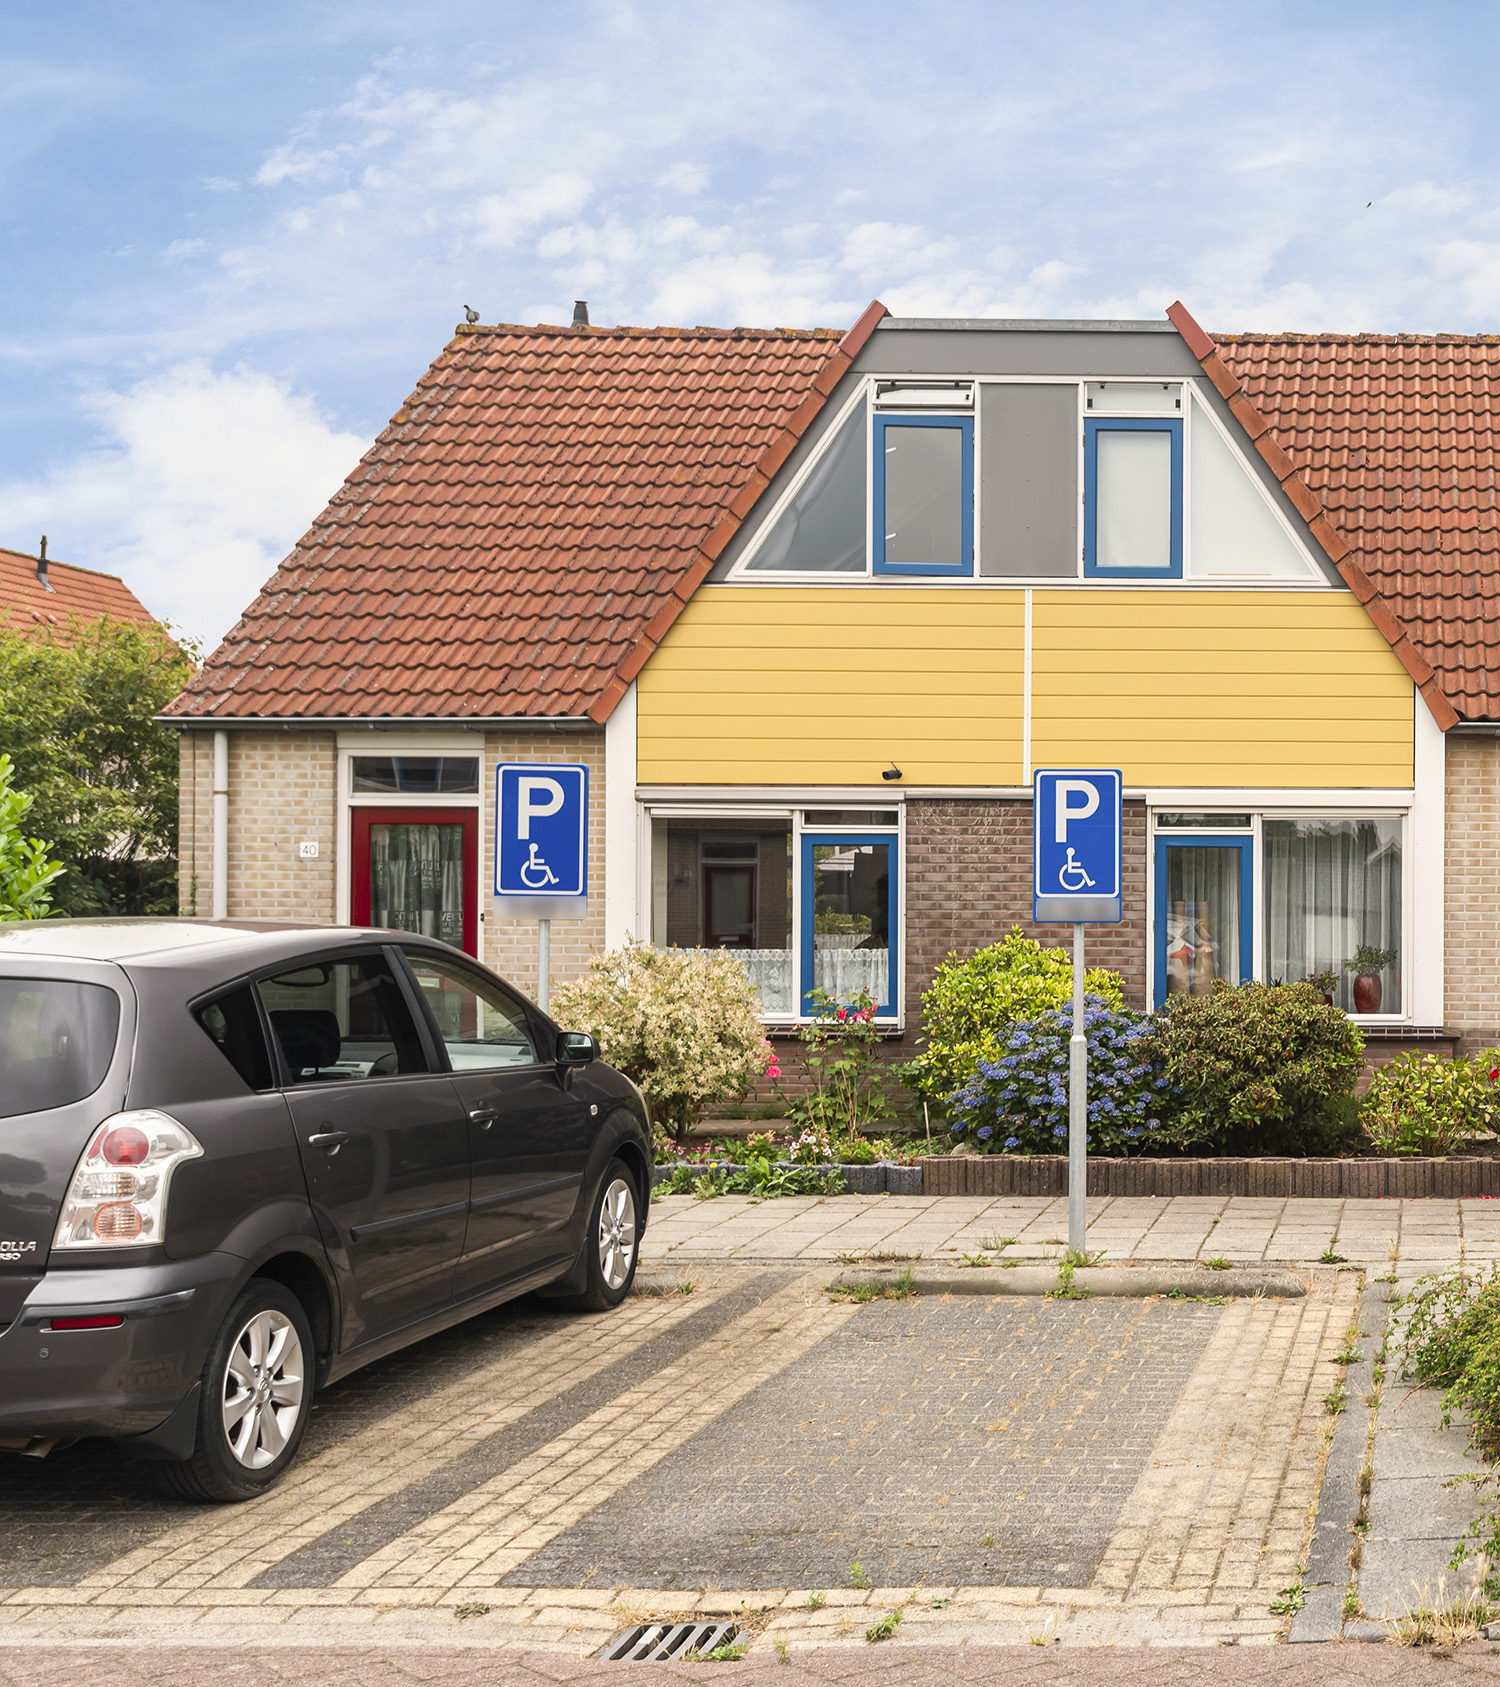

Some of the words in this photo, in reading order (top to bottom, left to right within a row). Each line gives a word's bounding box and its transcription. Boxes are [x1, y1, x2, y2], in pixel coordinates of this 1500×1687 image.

[518, 776, 565, 840] P
[1055, 780, 1100, 843] P
[302, 844, 317, 856] 40
